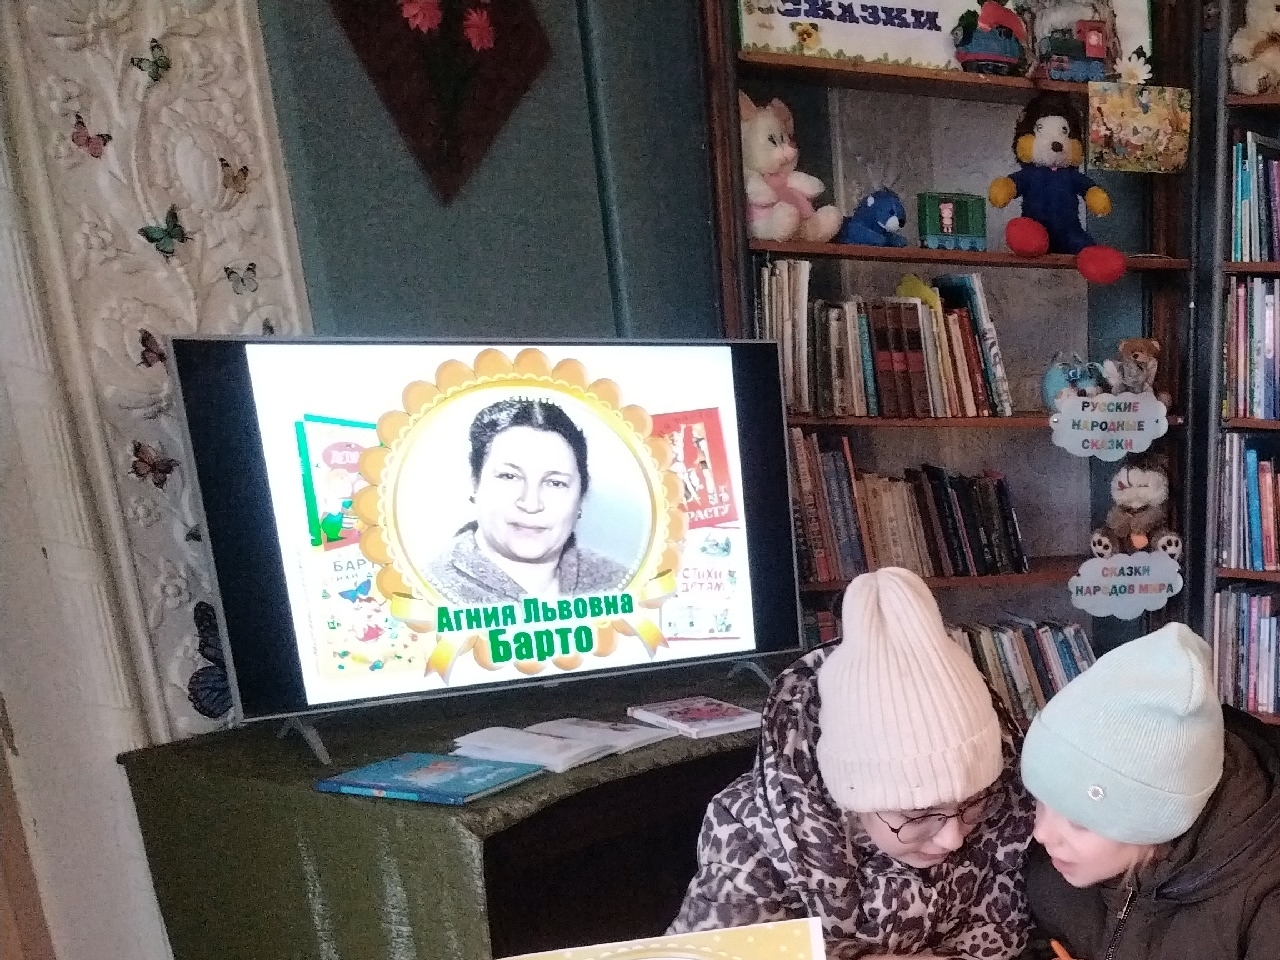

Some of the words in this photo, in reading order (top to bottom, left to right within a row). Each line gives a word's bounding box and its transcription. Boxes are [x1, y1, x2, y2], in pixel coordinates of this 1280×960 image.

[777, 0, 942, 32] СКАЗКИ
[1081, 401, 1140, 413] РУССКИЕ
[1071, 419, 1146, 432] НАРОДНЫЕ
[1081, 438, 1133, 450] СКАЗКИ
[1101, 565, 1151, 577] СКАЗКИ
[1075, 583, 1135, 596] НАРОДОВ
[1138, 583, 1174, 595] МИРА
[437, 602, 516, 632] Агния
[523, 591, 634, 626] Львовна
[489, 624, 593, 663] Барто
